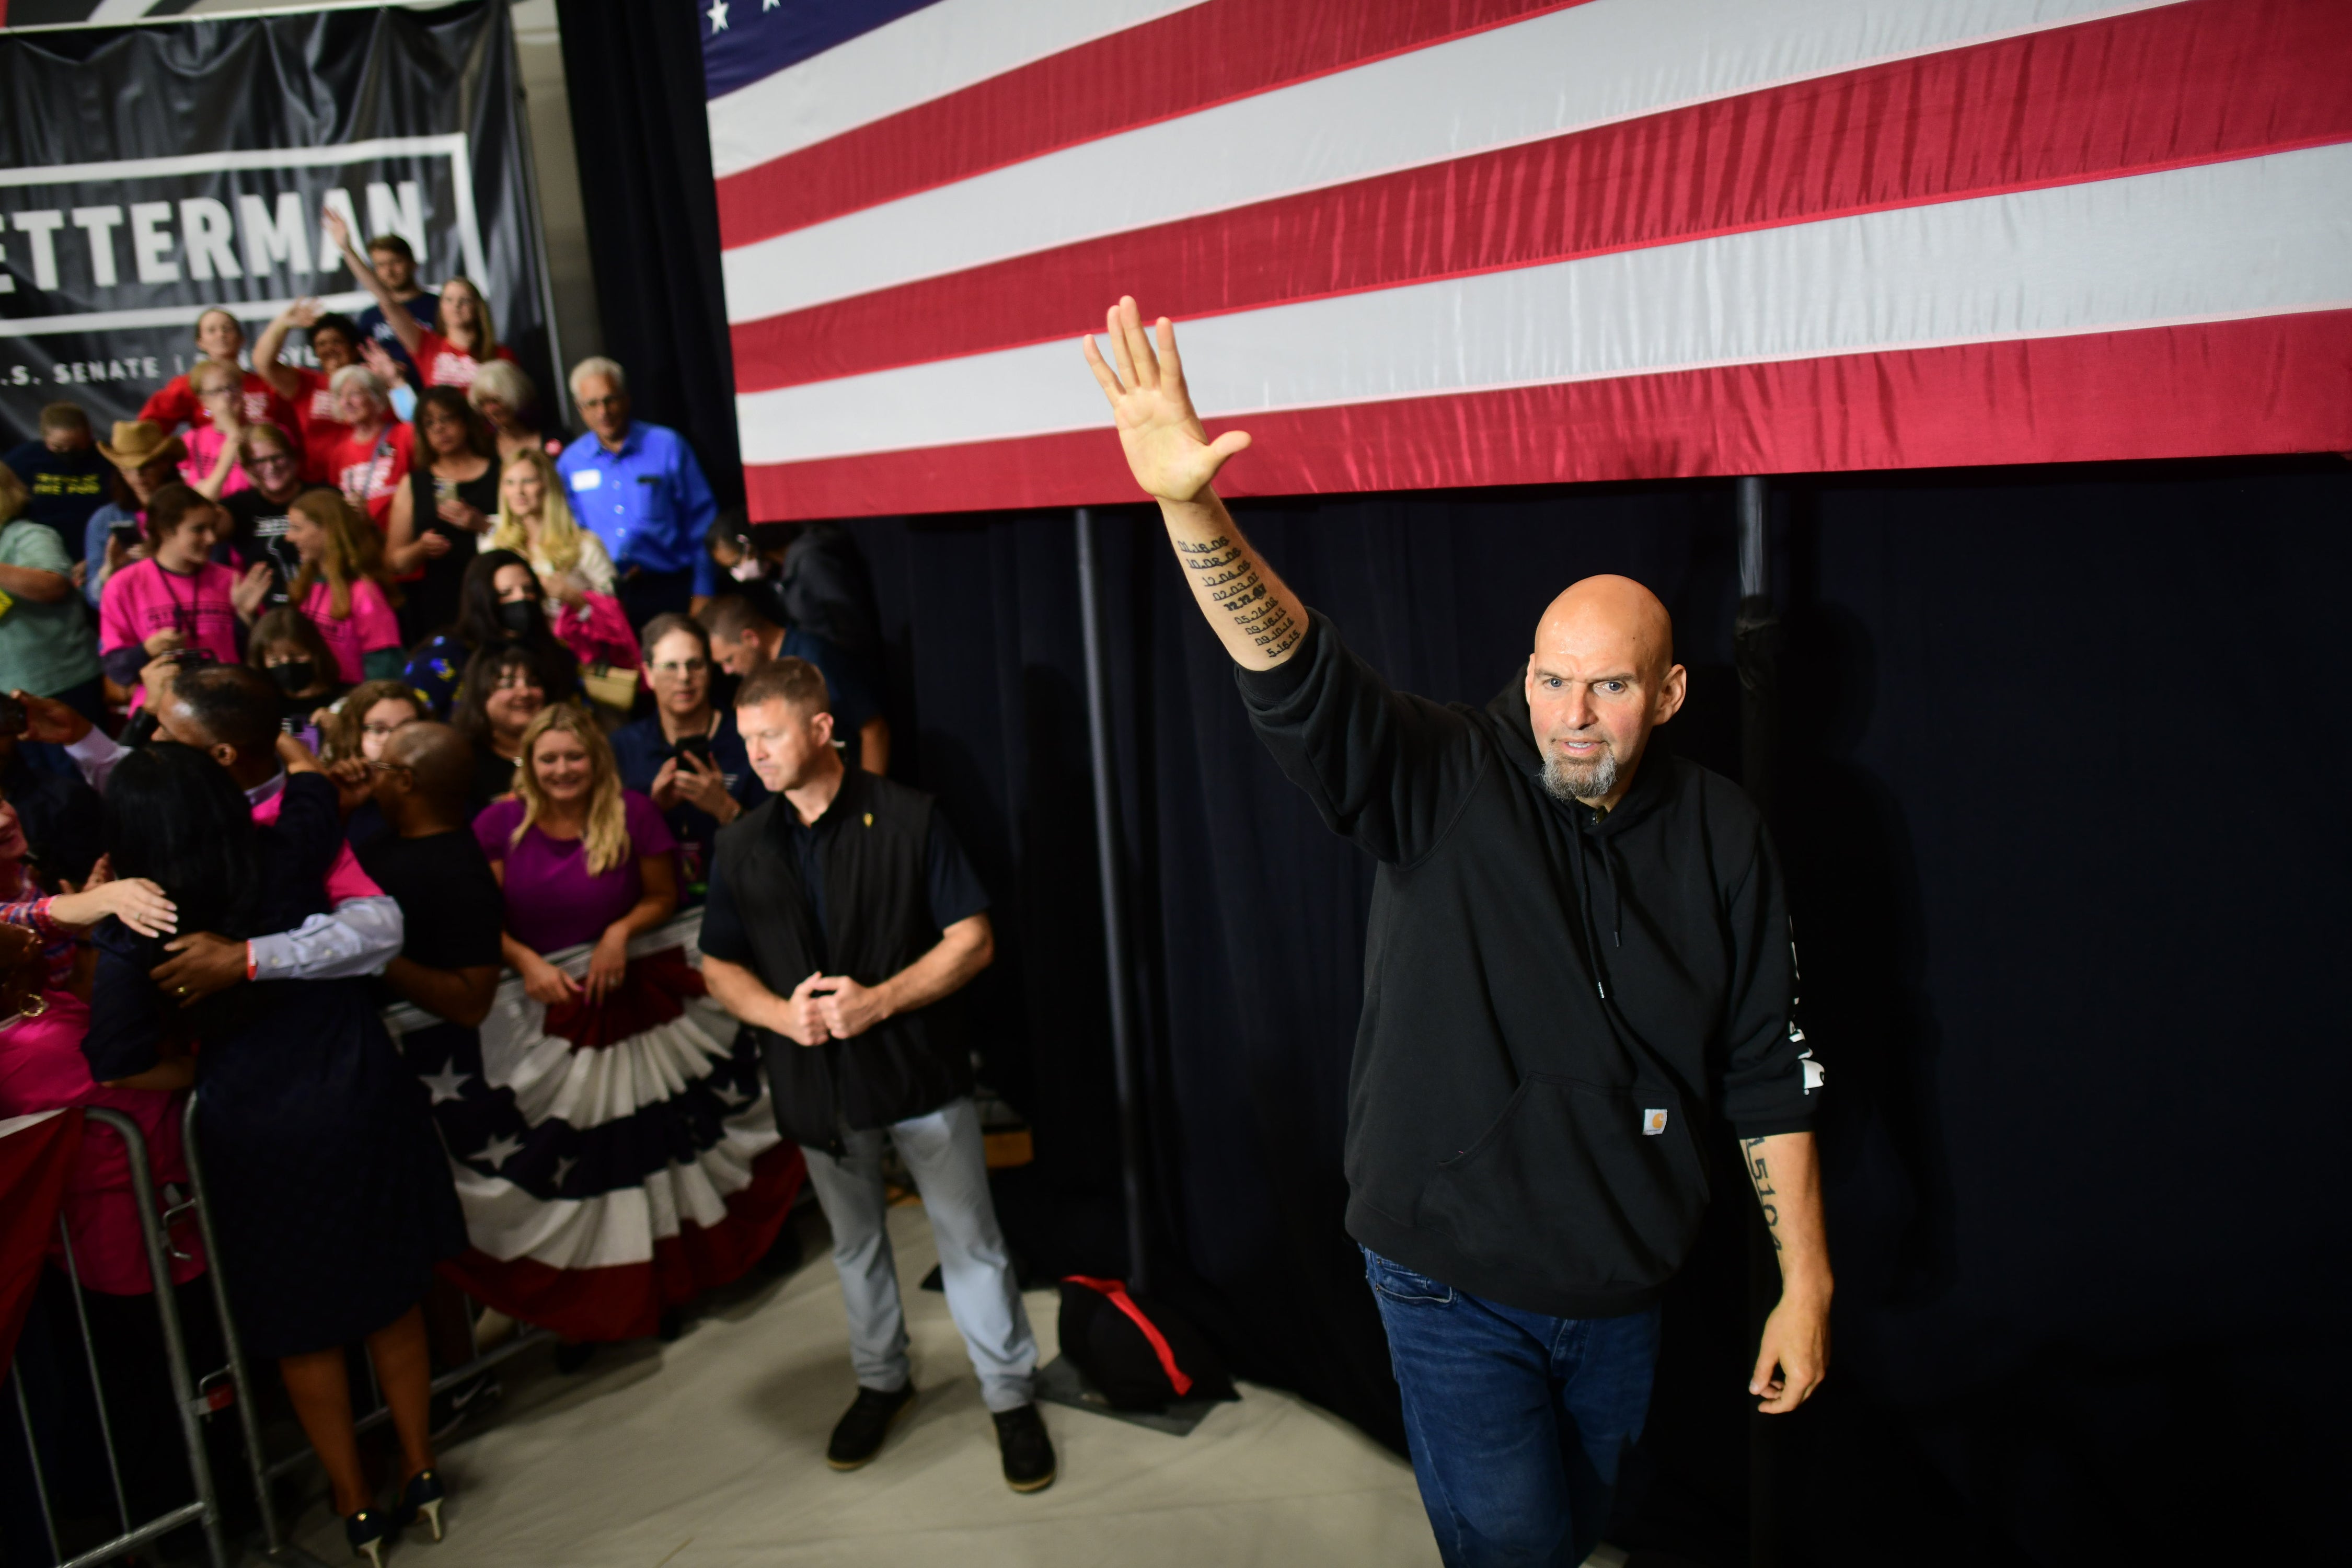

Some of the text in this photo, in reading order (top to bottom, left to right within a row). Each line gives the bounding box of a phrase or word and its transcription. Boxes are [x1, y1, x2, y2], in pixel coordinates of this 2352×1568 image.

[0, 181, 428, 294] TTERMAN
[53, 356, 158, 384] SENATE
[1234, 597, 1278, 625] 05.24.08
[1255, 617, 1295, 646] 09.10.14
